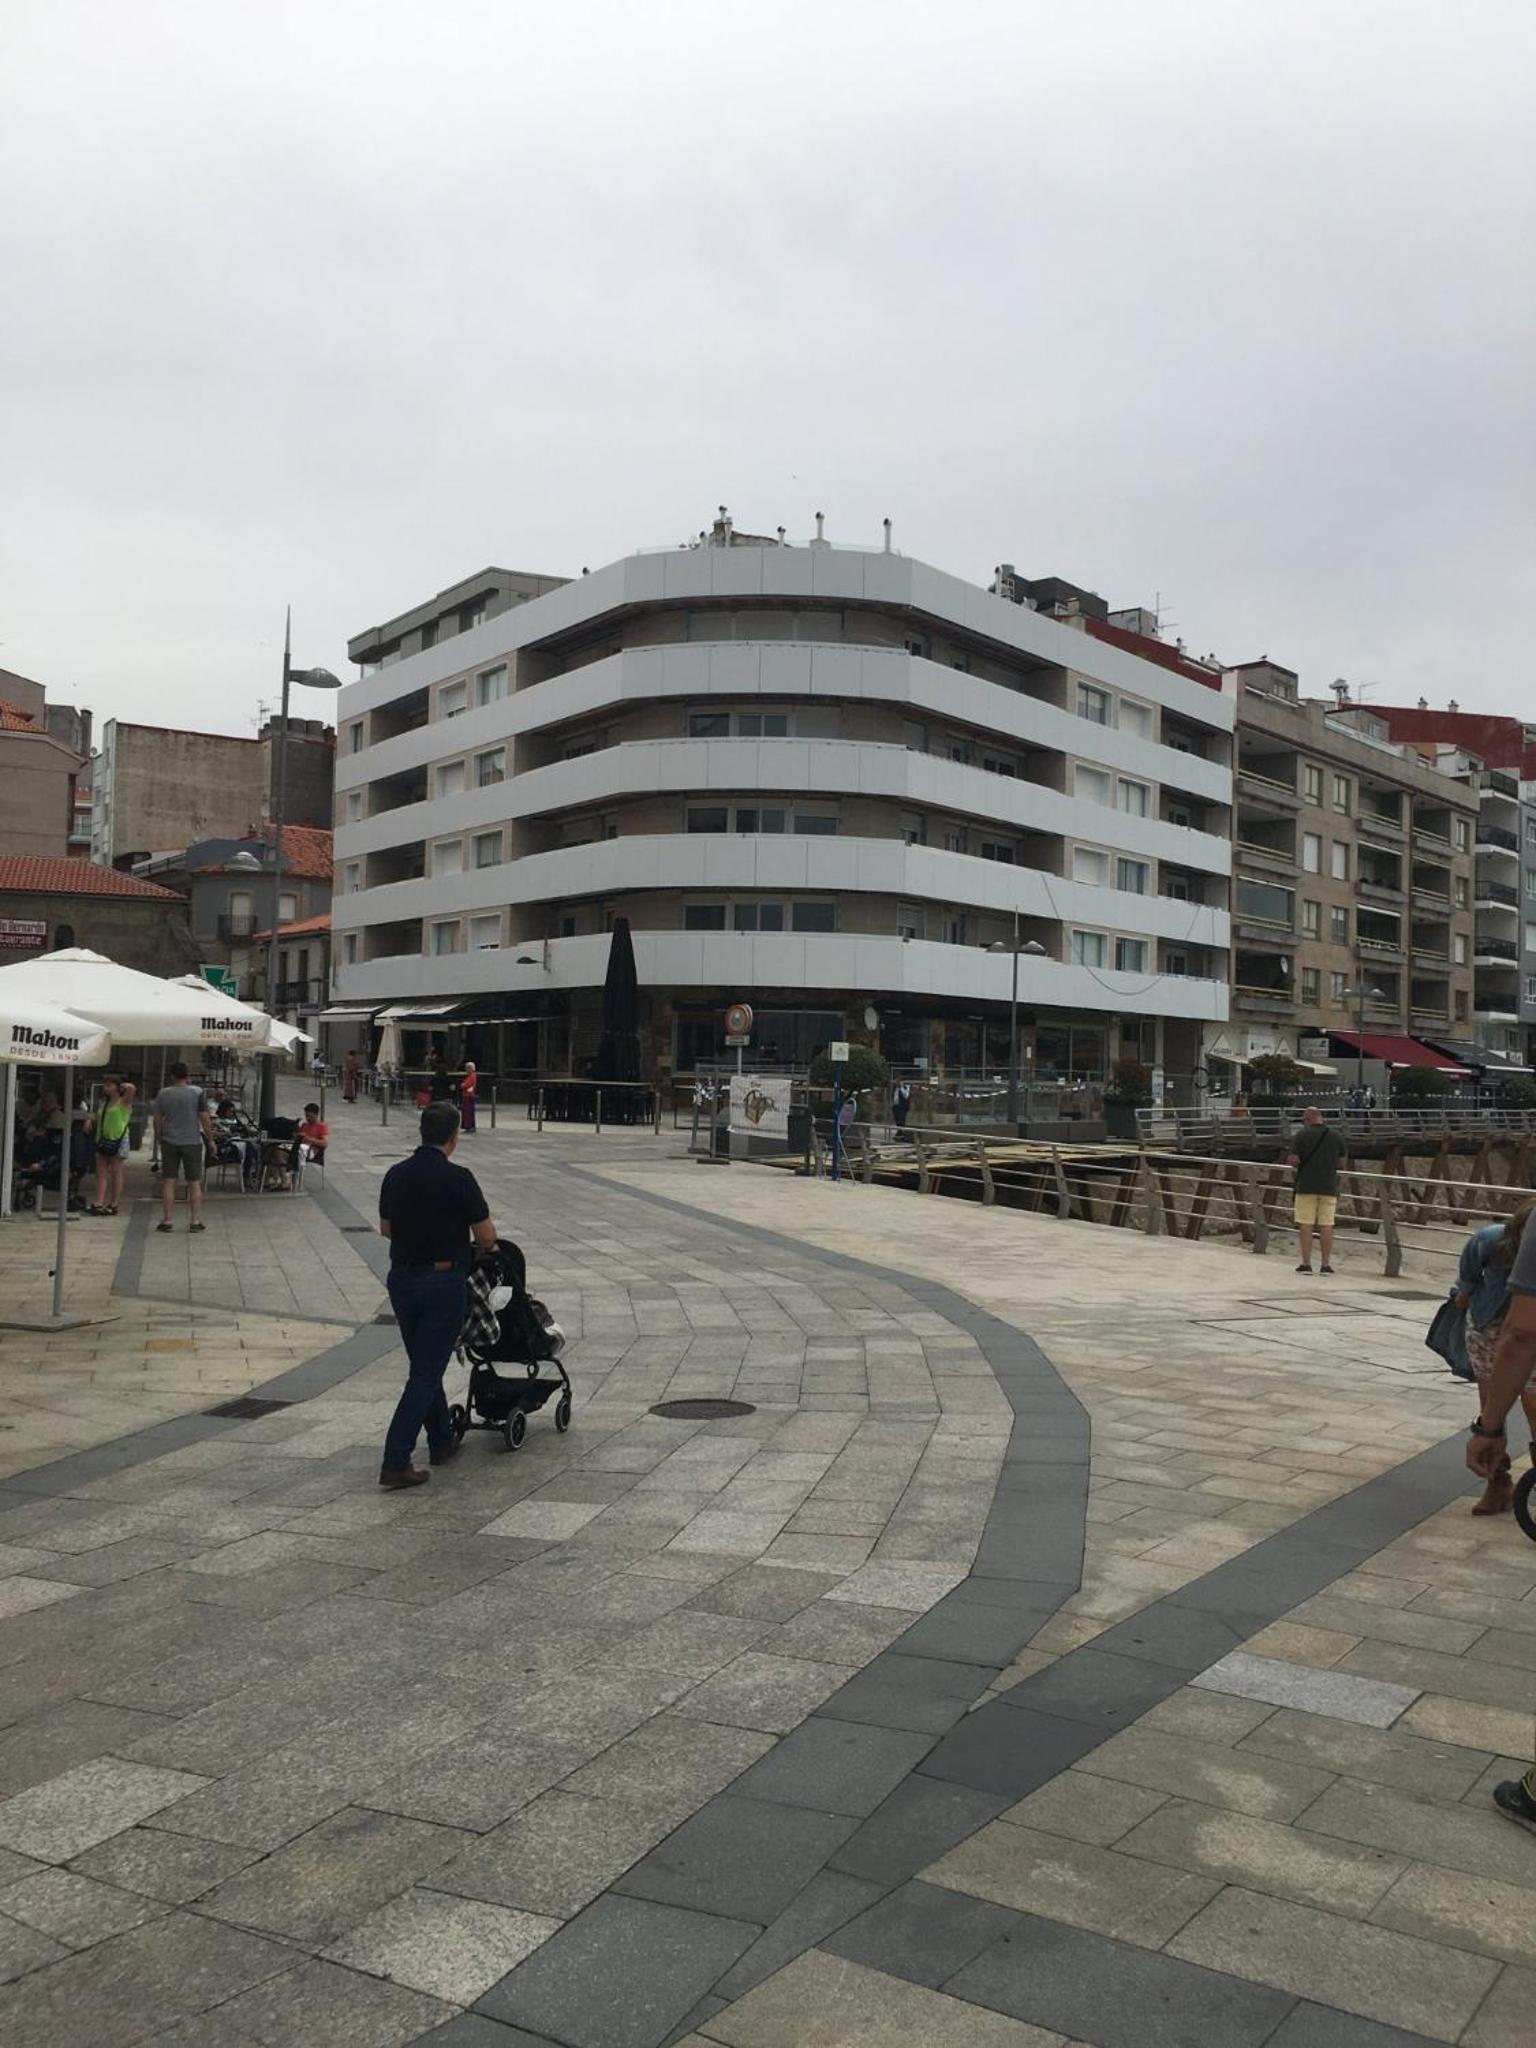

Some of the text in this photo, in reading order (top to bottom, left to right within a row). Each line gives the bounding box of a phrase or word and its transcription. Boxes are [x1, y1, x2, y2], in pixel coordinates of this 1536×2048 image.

[201, 1017, 253, 1031] Mahou
[11, 1024, 79, 1050] Mahou
[10, 1046, 47, 1058] DESDE
